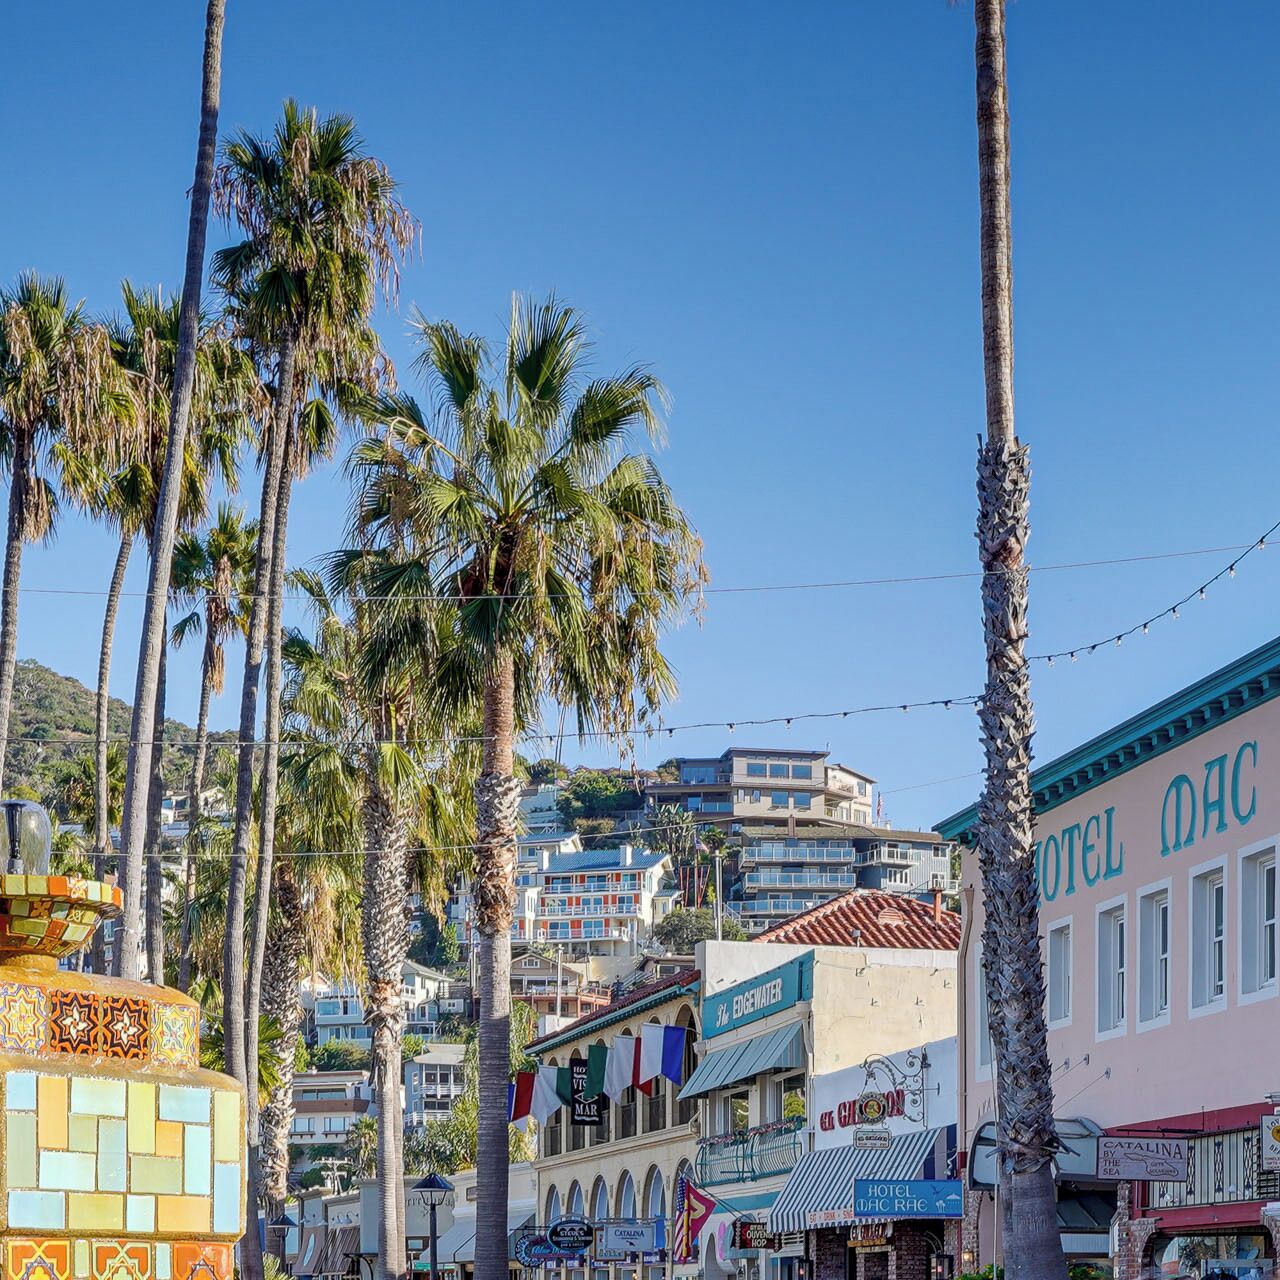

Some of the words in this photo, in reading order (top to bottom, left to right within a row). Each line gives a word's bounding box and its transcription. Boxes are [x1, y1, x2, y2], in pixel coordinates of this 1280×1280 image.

[1160, 740, 1258, 857] MAC
[732, 978, 782, 1019] EDGEWATER
[573, 1079, 587, 1090] VIS
[575, 1103, 598, 1115] MAR
[1103, 1141, 1183, 1160] CATALINA
[1103, 1168, 1120, 1176] SEA
[869, 1184, 916, 1197] HOTEL
[856, 1199, 890, 1212] MAC
[894, 1199, 928, 1212] RAE
[614, 1229, 645, 1237] CATALINA
